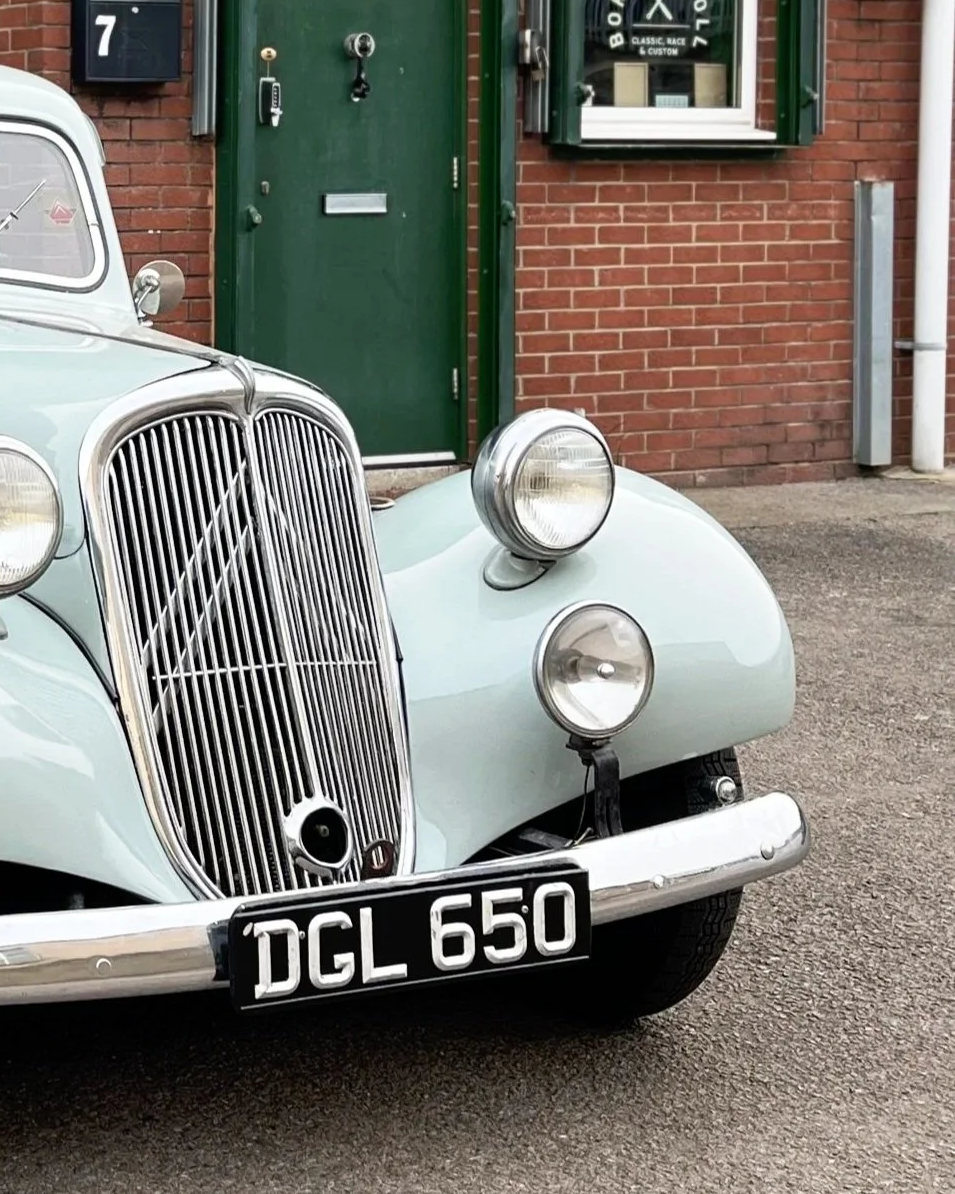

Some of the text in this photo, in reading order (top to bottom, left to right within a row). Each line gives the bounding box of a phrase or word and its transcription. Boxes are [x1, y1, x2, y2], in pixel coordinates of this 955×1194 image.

[95, 14, 116, 57] 7
[667, 37, 686, 46] RACE
[648, 47, 679, 56] CUSTOM
[253, 882, 577, 1000] DGL 650
